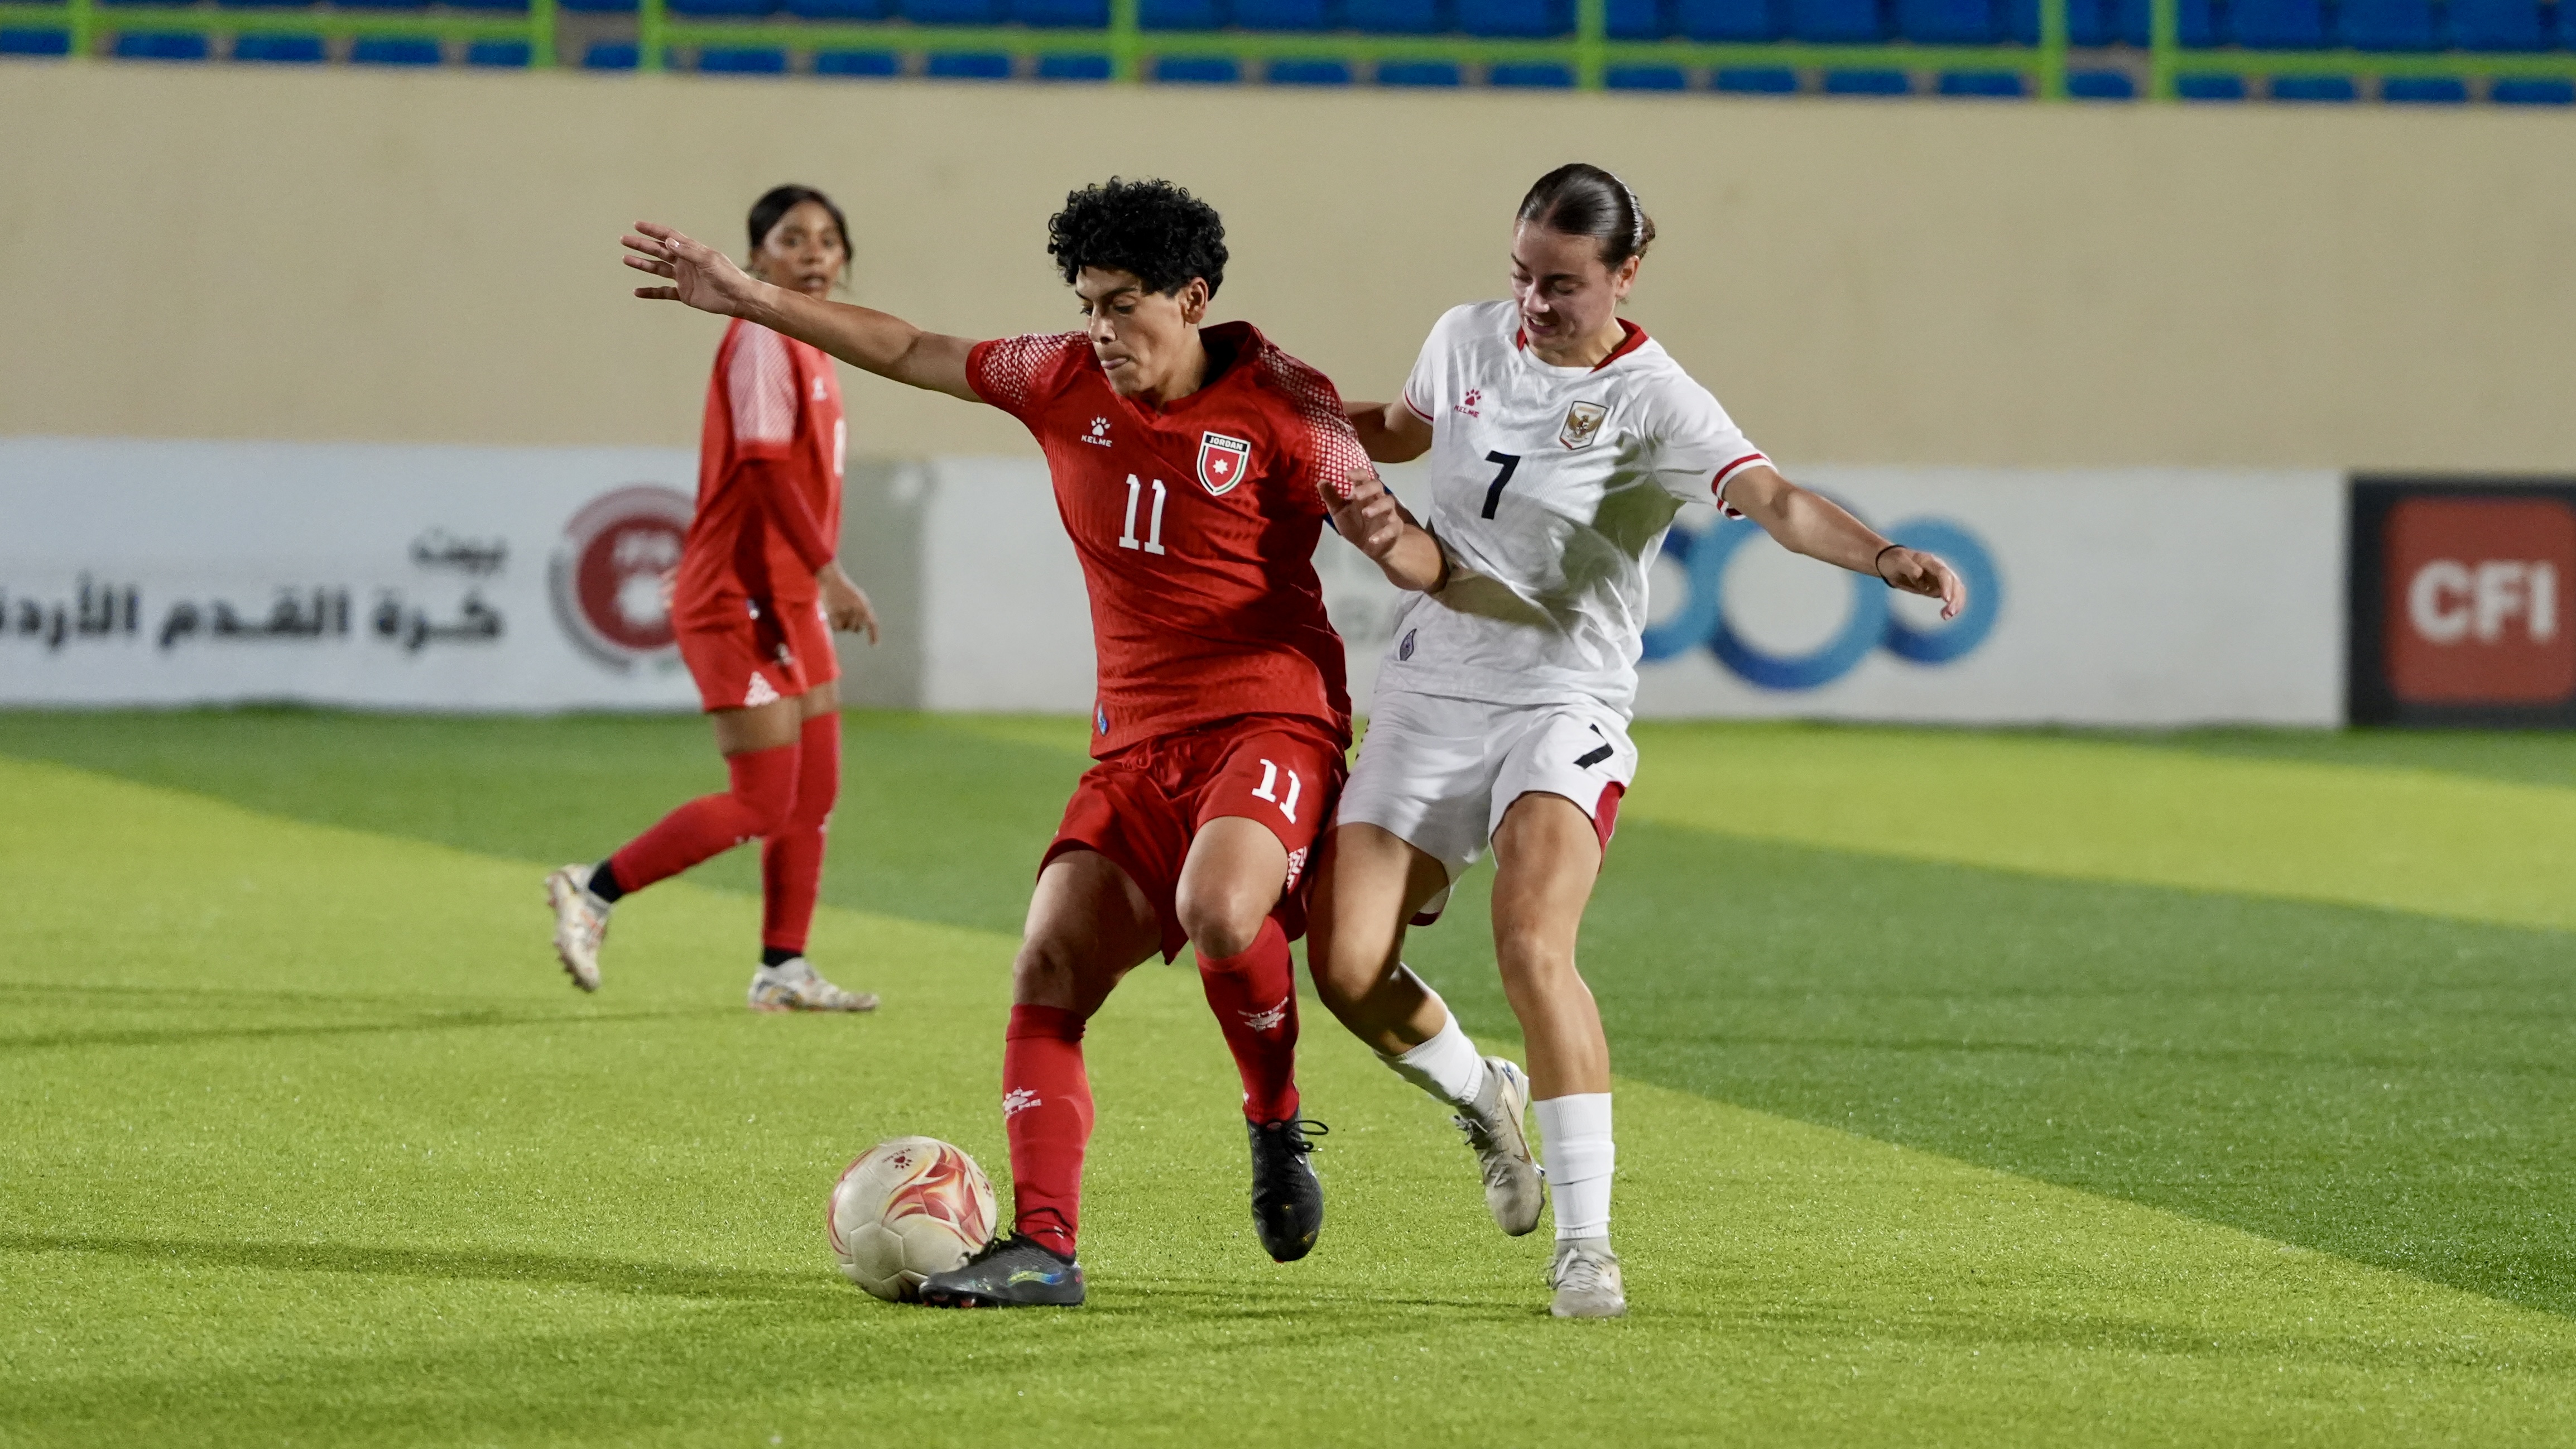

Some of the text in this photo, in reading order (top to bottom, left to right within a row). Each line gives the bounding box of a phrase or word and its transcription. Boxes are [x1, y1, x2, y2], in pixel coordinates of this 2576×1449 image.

[1081, 435, 1113, 447] KELME
[1209, 436, 1244, 451] JORDAN
[1453, 405, 1479, 418] KELME
[1118, 473, 1167, 556] 11
[1481, 450, 1521, 520] 7
[0, 568, 506, 654] كرة القدم الأرد
[2407, 559, 2559, 646] CFI
[1572, 722, 1614, 770] 7
[1251, 758, 1301, 824] 11
